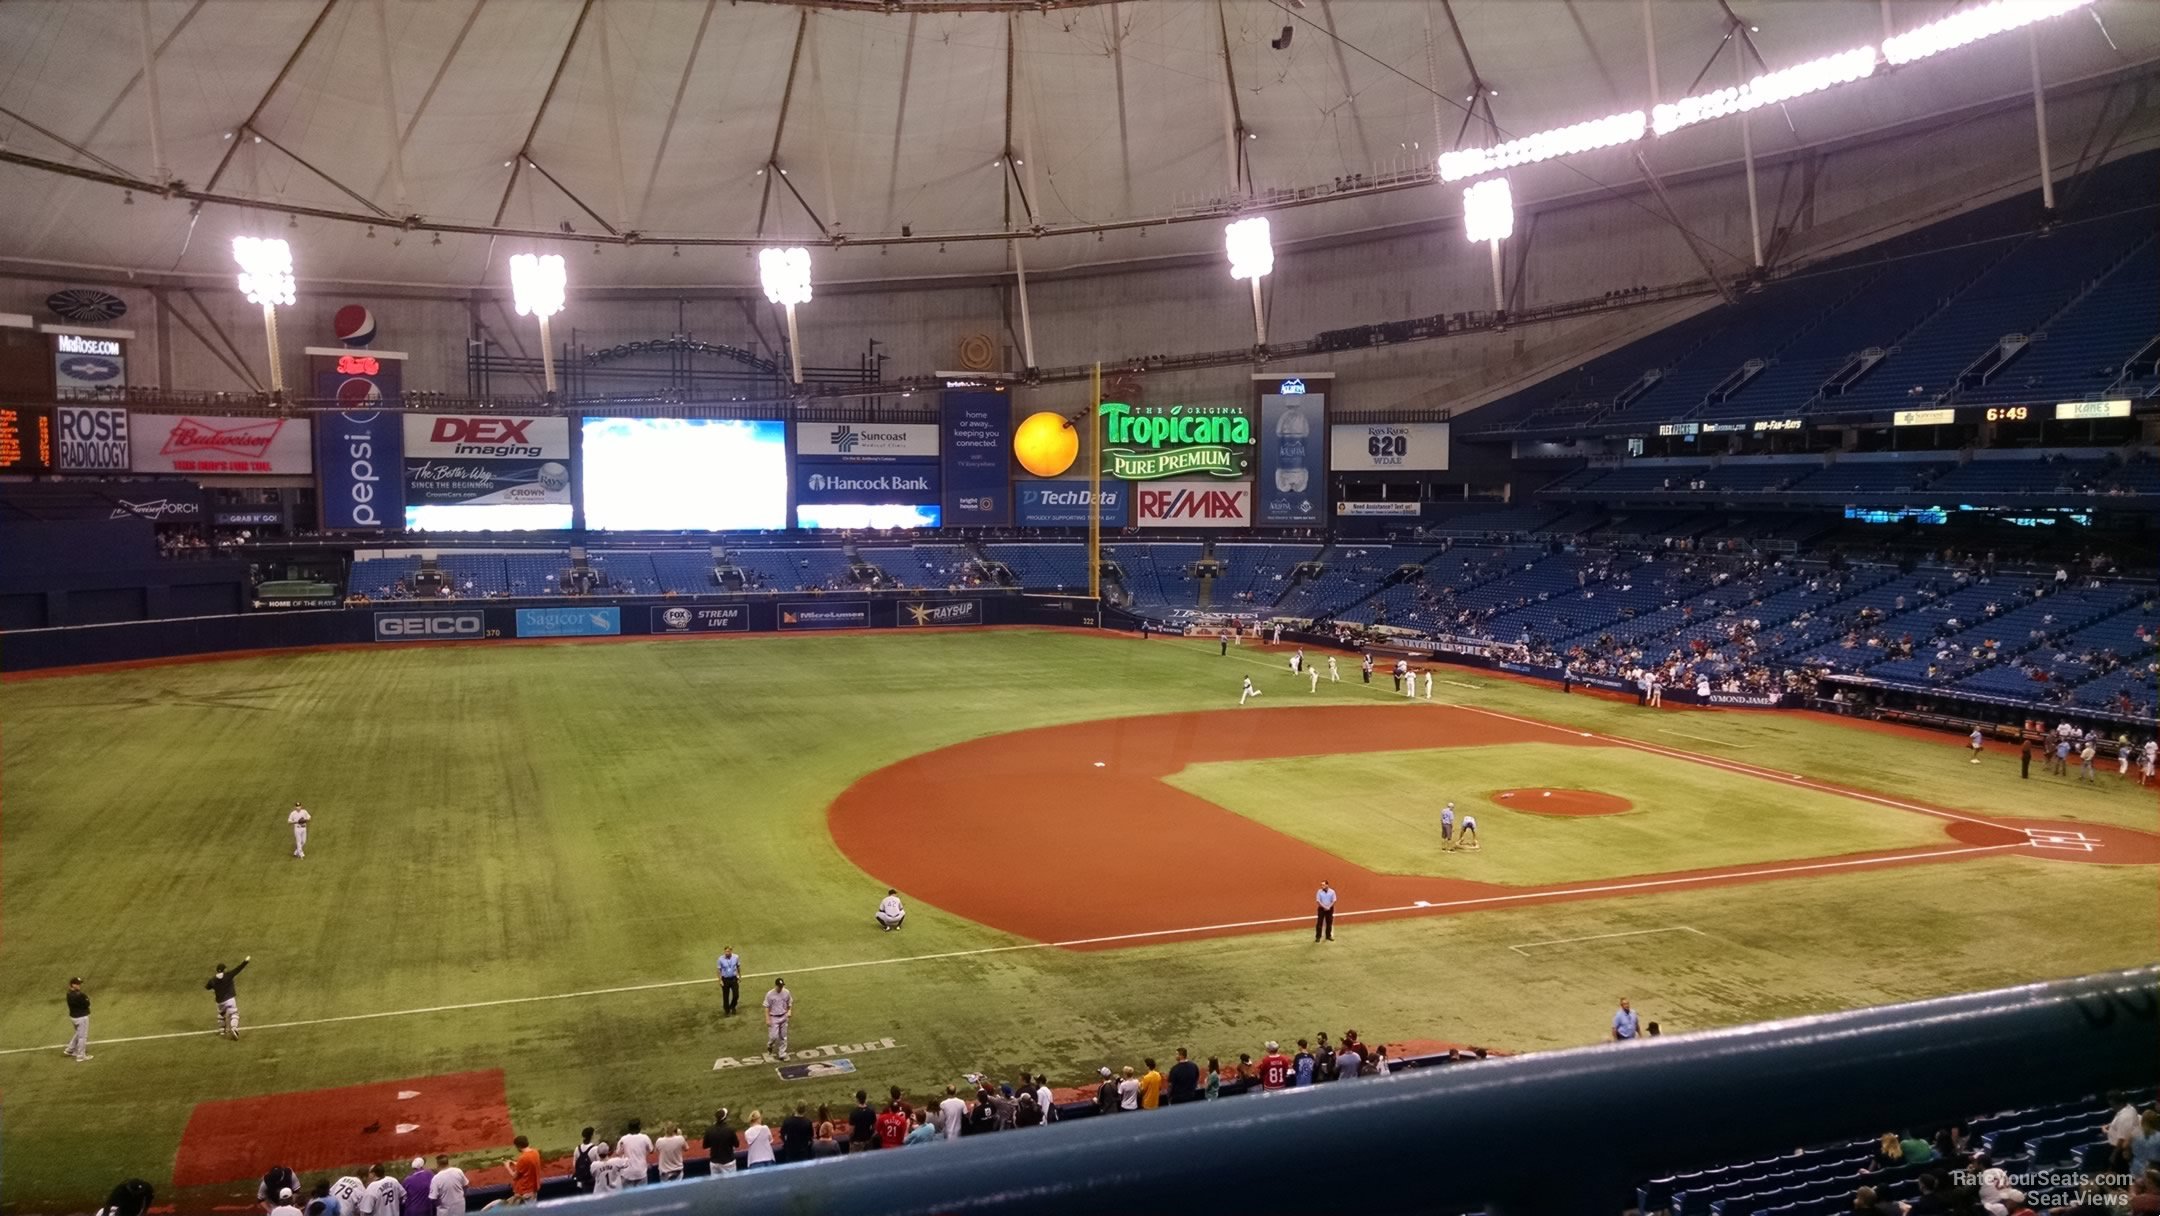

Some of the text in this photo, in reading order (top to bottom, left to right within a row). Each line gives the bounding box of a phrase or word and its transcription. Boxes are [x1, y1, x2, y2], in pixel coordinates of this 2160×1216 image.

[966, 411, 987, 419] home
[1986, 407, 2027, 420] 6:49
[59, 410, 126, 441] ROSE
[430, 418, 534, 444] DEX
[954, 429, 999, 438] keeping you
[1098, 403, 1249, 448] Tropicana
[171, 428, 272, 446] Budweiser
[861, 431, 907, 441] Suncoast
[455, 443, 542, 457] imaging
[1368, 436, 1407, 456] 620
[60, 442, 126, 467] RADIOLOGY
[1115, 451, 1231, 474] PURE PREMIUM
[414, 461, 431, 480] The
[434, 465, 468, 480] Better
[344, 434, 381, 525] pepsi
[411, 481, 434, 489] SINCE
[827, 476, 929, 490] Hancock Bank
[163, 503, 199, 513] PORCH
[1140, 489, 1243, 519] RE/MAX
[527, 611, 586, 629] Sagicor
[698, 610, 738, 618] STREAM
[379, 617, 480, 635] GEICO
[708, 619, 728, 627] LIVE
[486, 629, 501, 637] 370
[1709, 695, 1745, 704] AYMOND
[713, 1037, 897, 1070] AstroTurf
[1269, 1067, 1284, 1084] 81
[887, 1125, 897, 1137] 21
[335, 1184, 353, 1200] 79
[382, 1190, 395, 1206] 79
